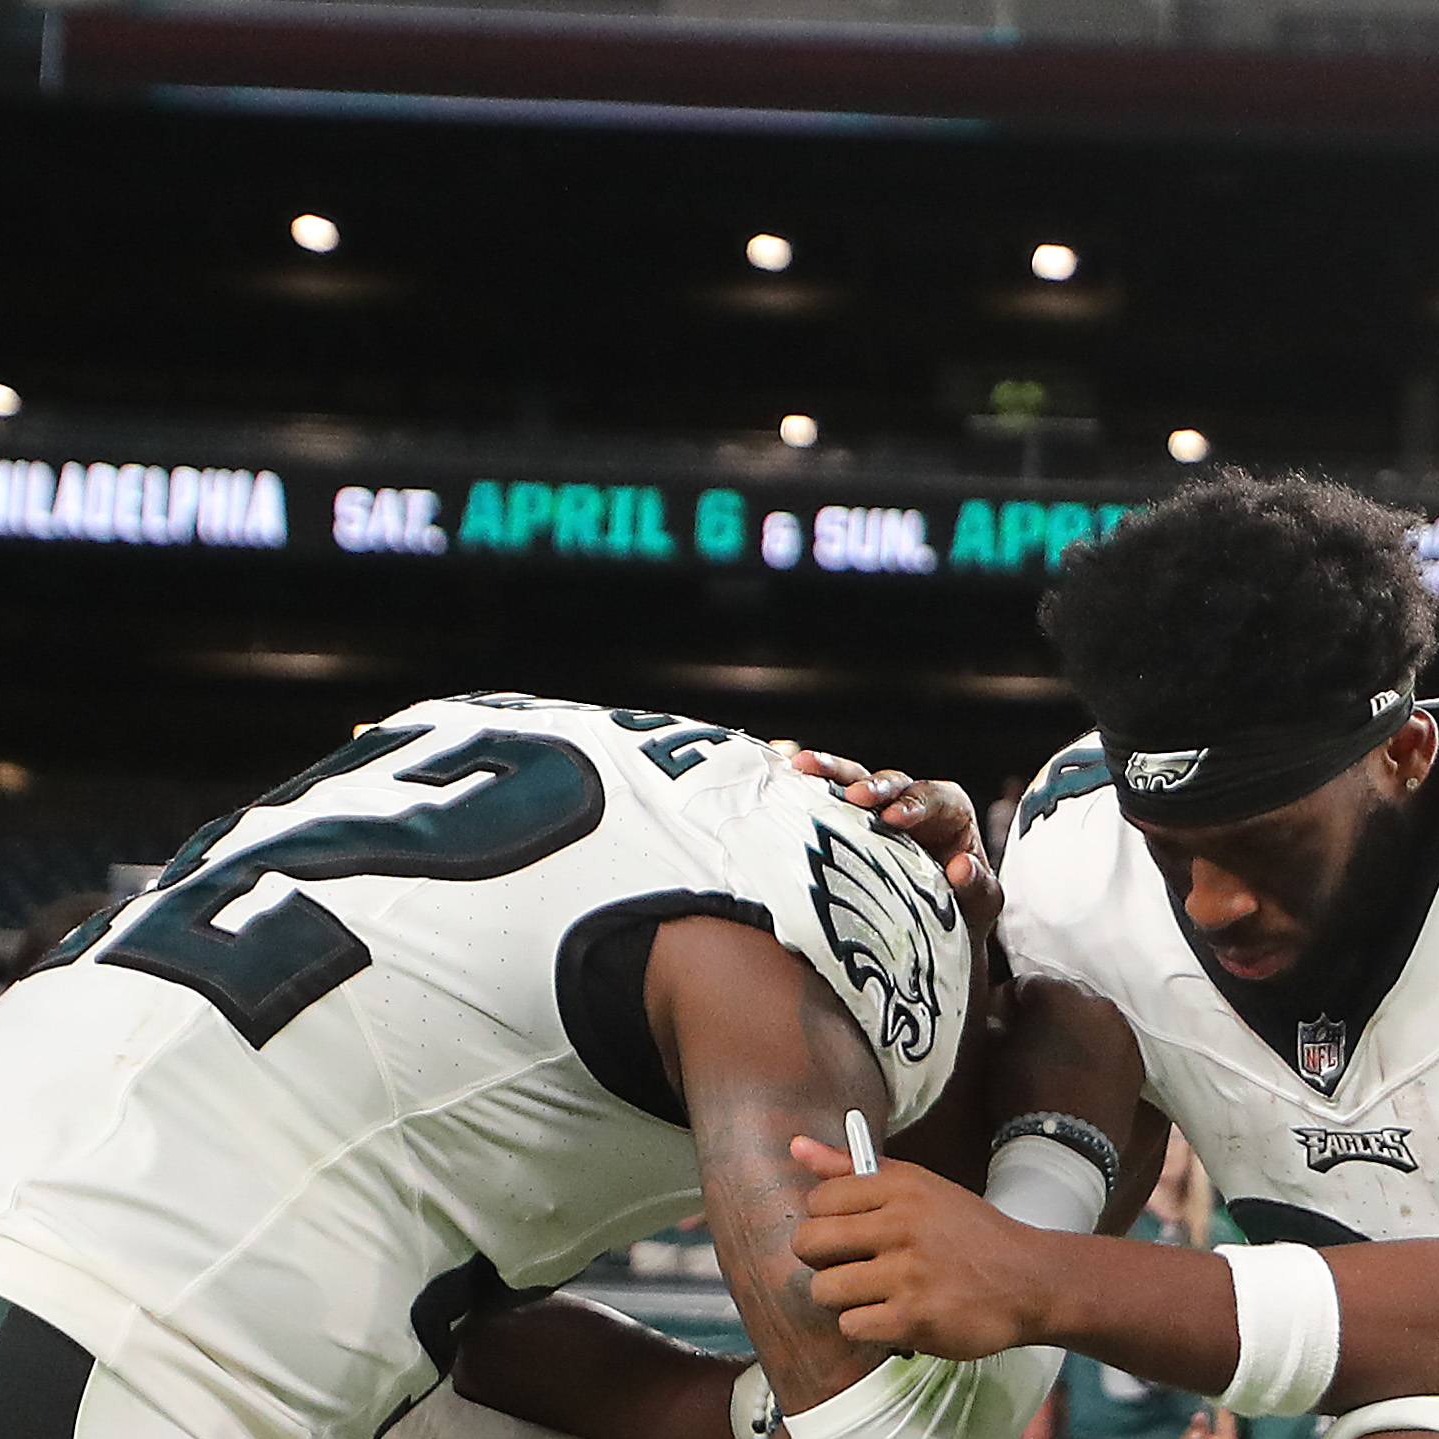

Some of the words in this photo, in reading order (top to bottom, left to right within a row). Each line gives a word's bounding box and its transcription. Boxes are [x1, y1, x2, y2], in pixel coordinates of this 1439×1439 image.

[333, 485, 448, 554] SAT.
[460, 479, 675, 562] APRIL
[695, 487, 746, 562] 6
[812, 505, 937, 575] SUN.
[947, 497, 1153, 572] APR
[1303, 1045, 1338, 1075] NFL
[1289, 1126, 1420, 1174] EAGLES
